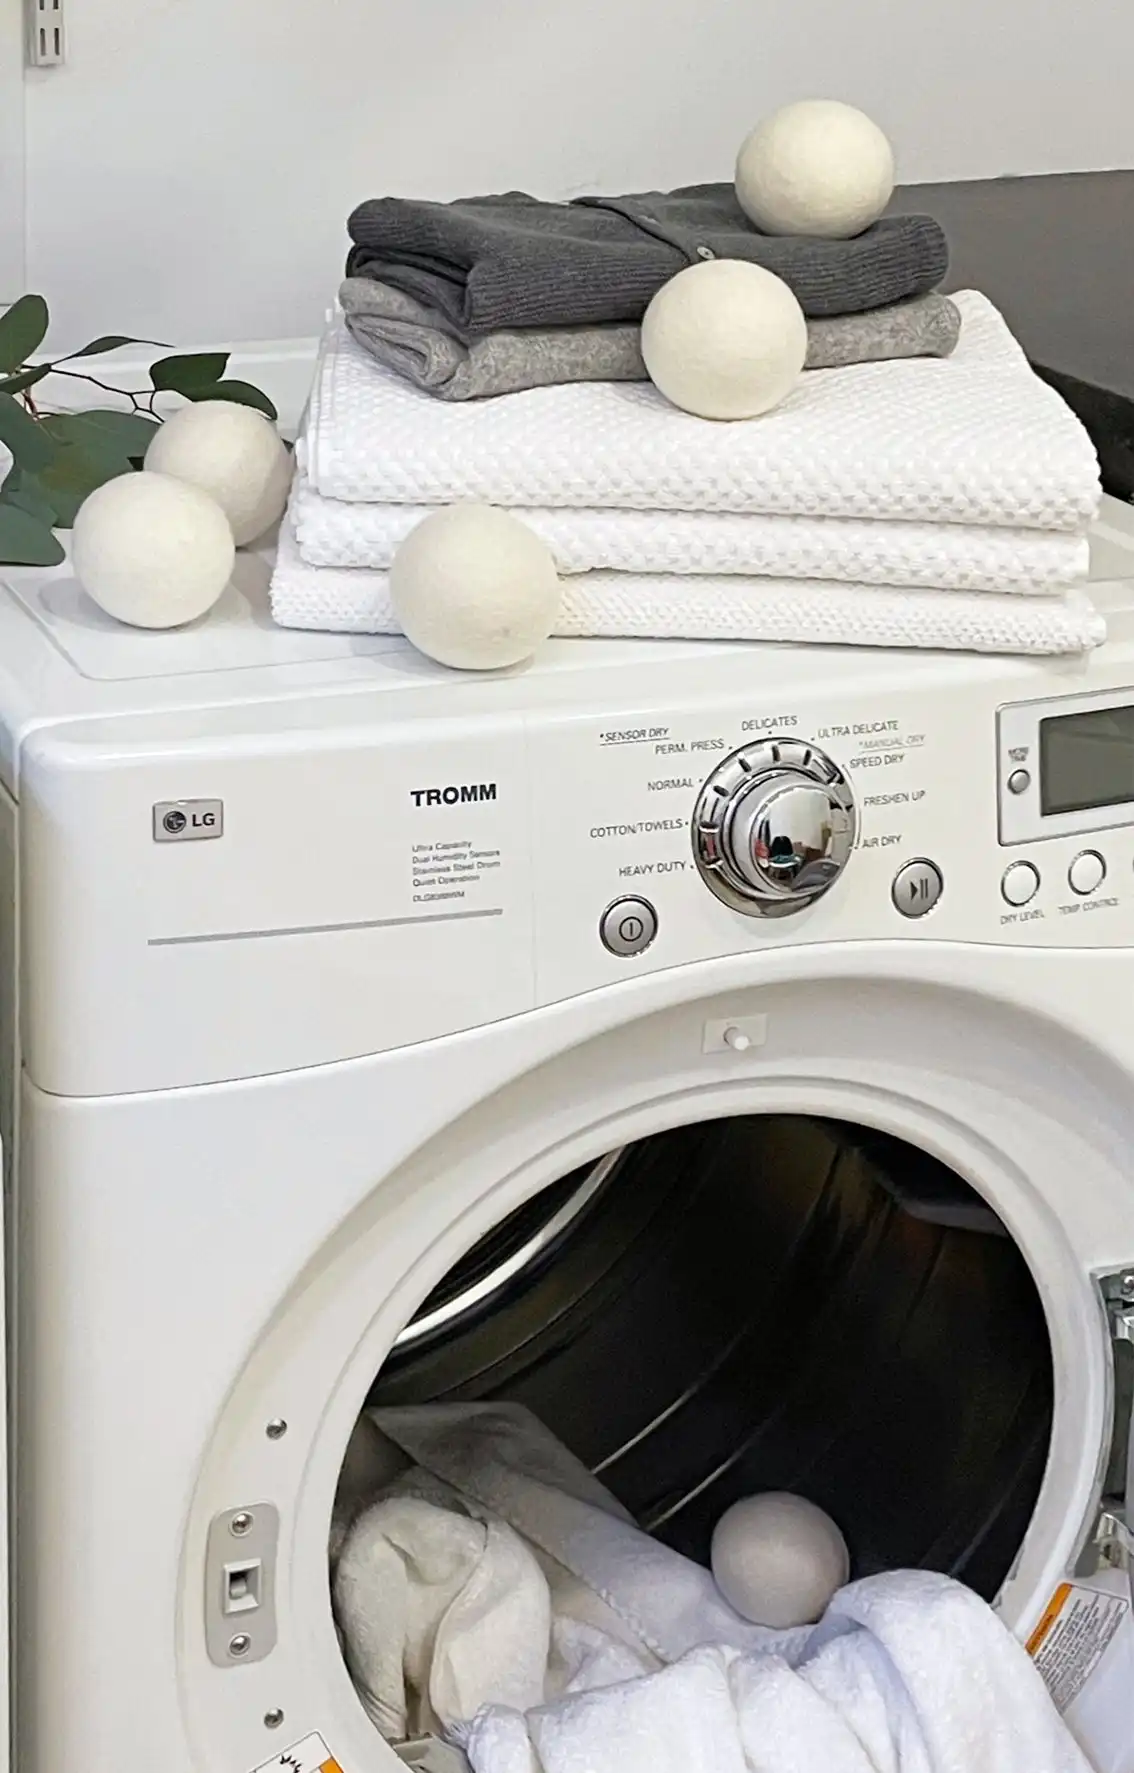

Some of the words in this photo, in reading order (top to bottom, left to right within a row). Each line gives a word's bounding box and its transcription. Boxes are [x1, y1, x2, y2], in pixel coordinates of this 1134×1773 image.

[741, 716, 798, 731] DELICATES
[818, 726, 851, 739] ULTRA
[852, 720, 899, 735] DELICATE
[648, 727, 670, 738] DRY
[690, 738, 725, 751] PRESS
[850, 754, 882, 769] SPEED
[884, 754, 905, 766] DRY
[647, 778, 694, 791] NORMAL
[410, 783, 497, 807] TROMM
[192, 812, 216, 828] LG
[618, 864, 654, 877] HEAVY
[656, 861, 687, 873] DUTY
